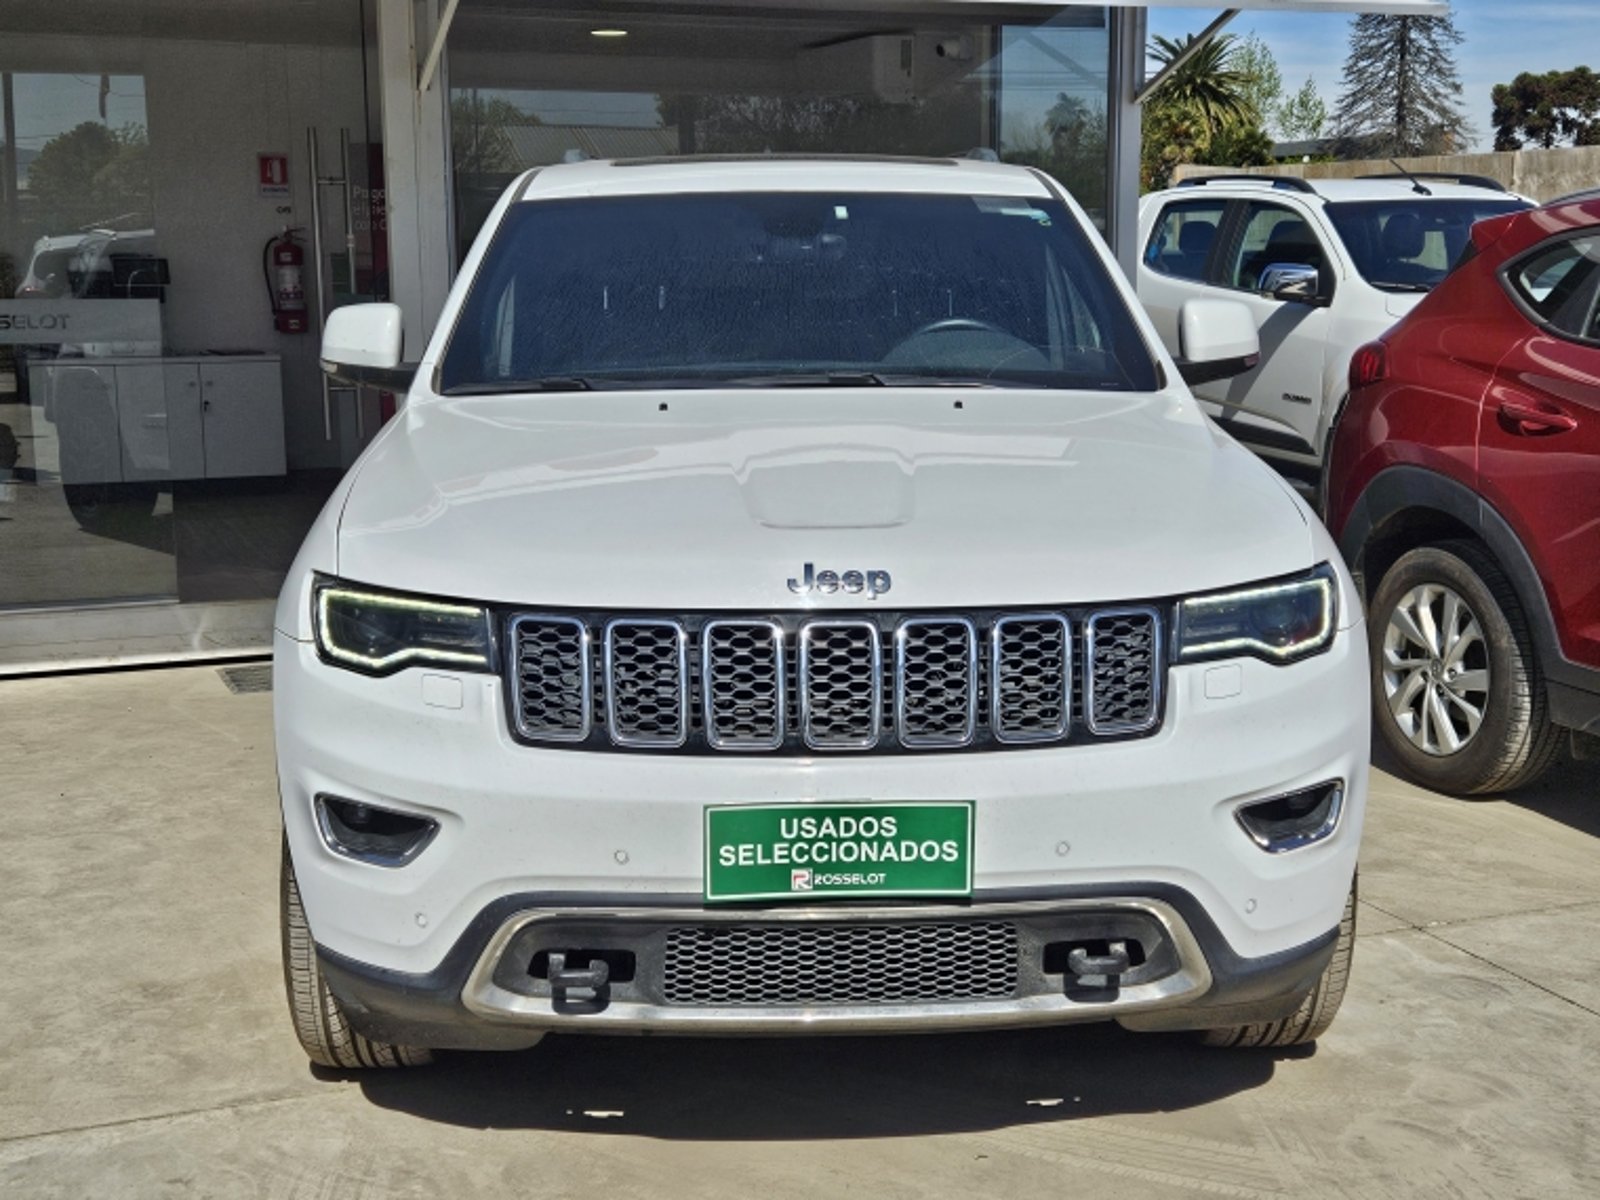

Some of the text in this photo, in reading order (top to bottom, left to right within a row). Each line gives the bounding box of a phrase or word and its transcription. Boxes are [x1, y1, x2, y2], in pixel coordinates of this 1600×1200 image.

[787, 562, 891, 600] Jeep
[780, 816, 897, 838] USADOS
[719, 840, 958, 866] SELECCIONADOS
[814, 873, 886, 885] ROSSELOT
